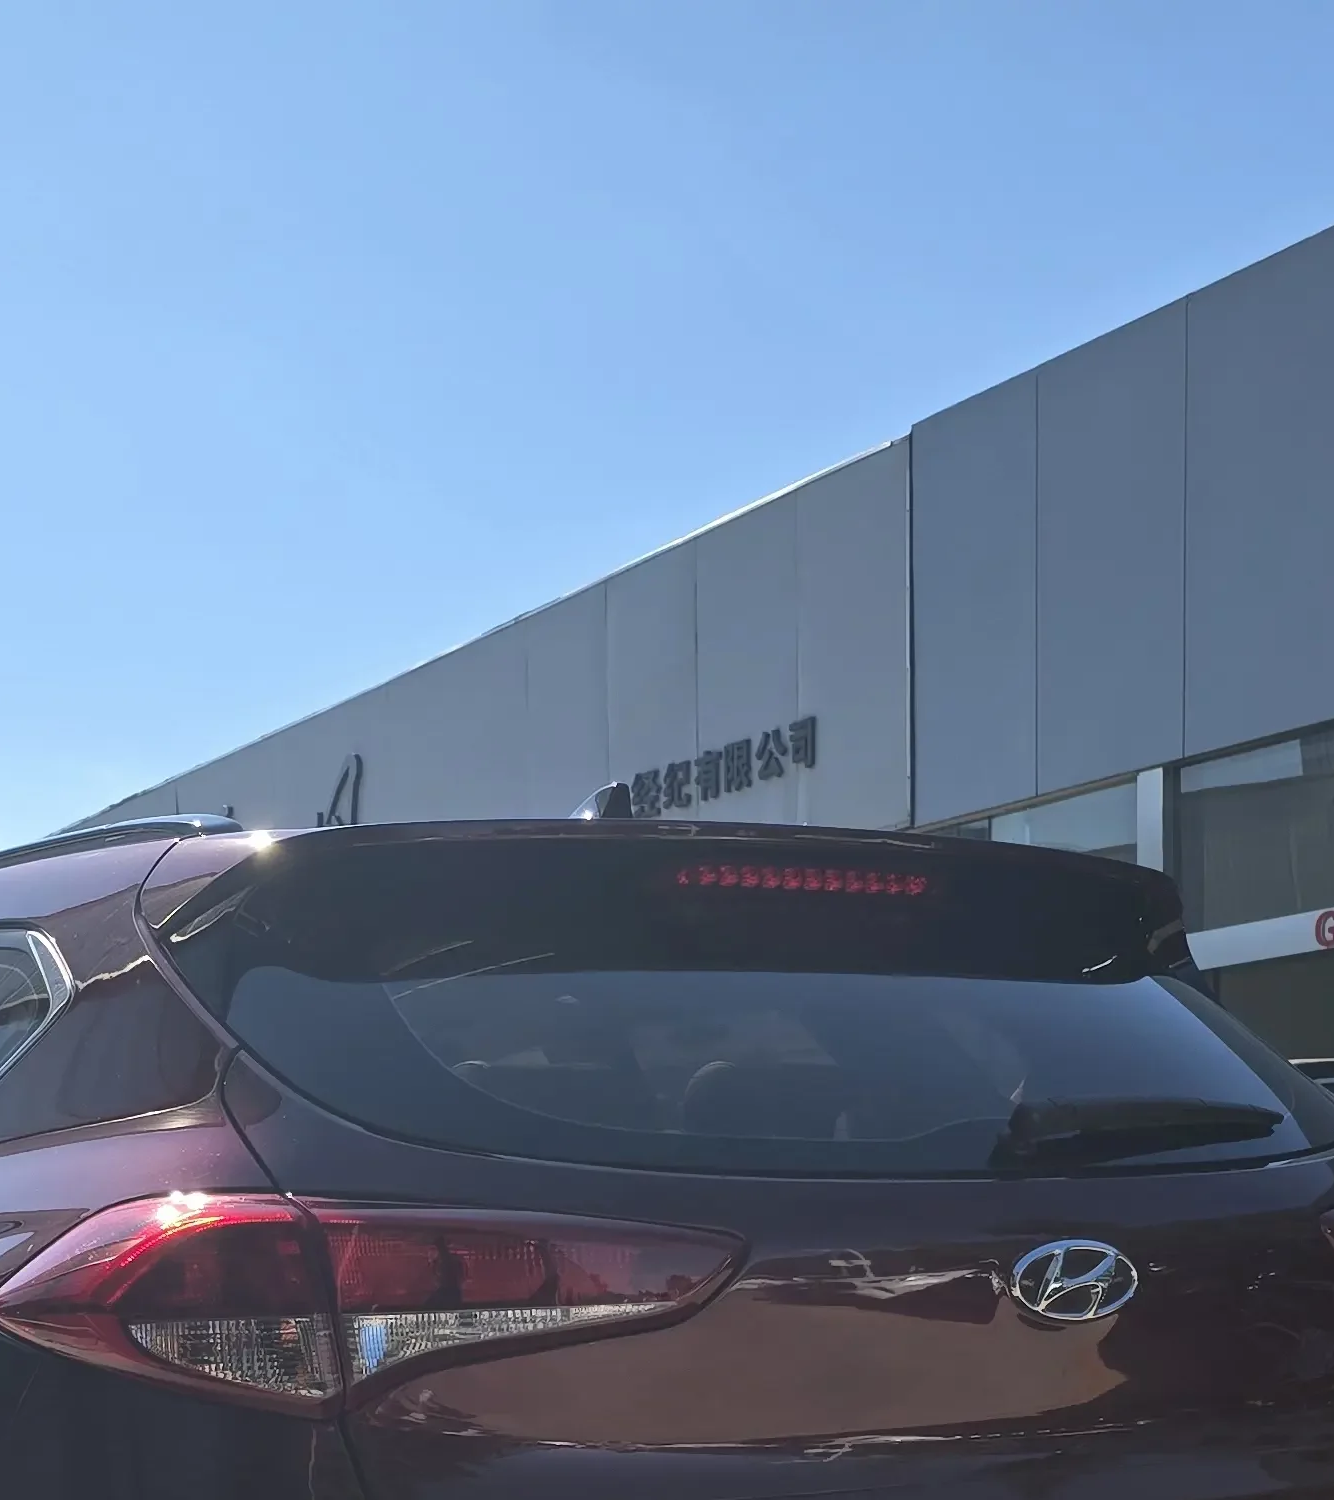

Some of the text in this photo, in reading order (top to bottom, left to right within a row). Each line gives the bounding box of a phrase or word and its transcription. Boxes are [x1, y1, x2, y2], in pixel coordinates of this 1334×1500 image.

[631, 715, 816, 818] 经纪有限公司
